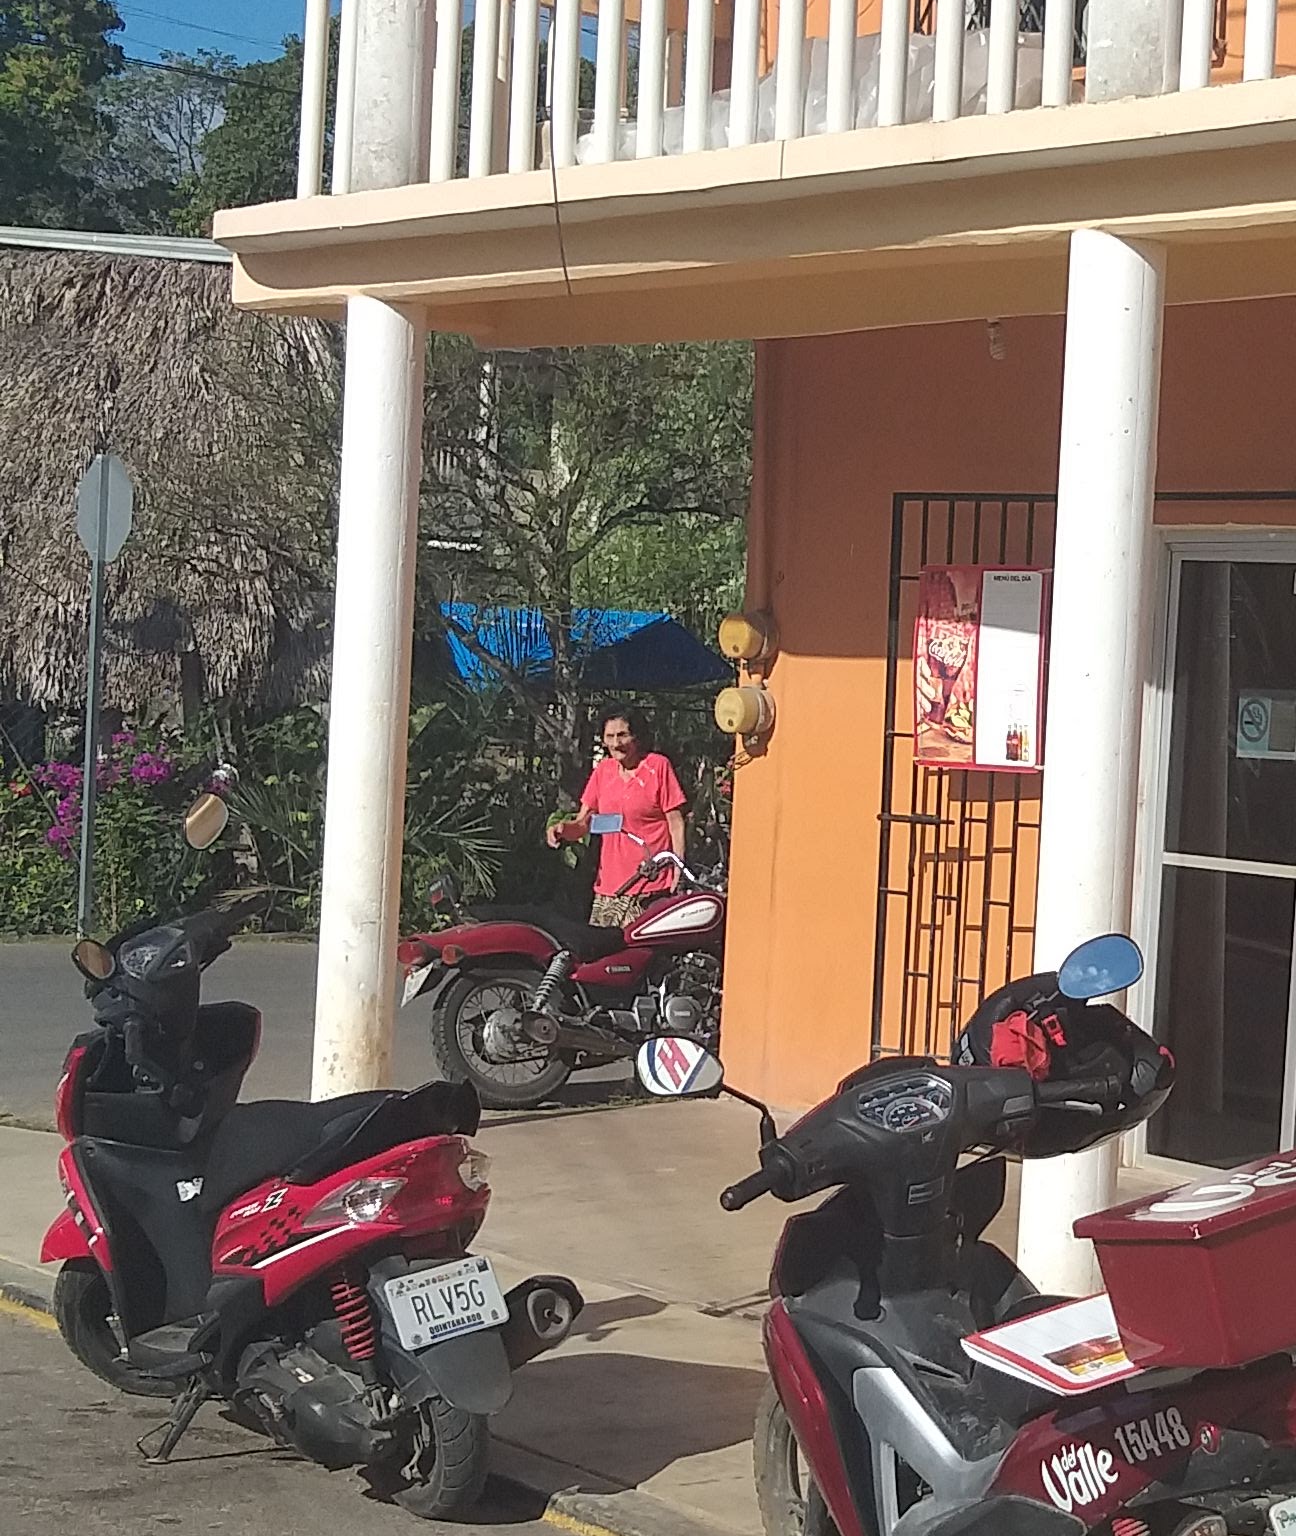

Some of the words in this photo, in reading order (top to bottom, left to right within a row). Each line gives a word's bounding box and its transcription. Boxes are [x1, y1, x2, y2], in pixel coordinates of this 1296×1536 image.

[410, 1279, 486, 1325] RLV5G
[429, 1317, 467, 1334] QUINTANA
[466, 1312, 482, 1323] ROO
[1061, 1443, 1078, 1471] del
[1114, 1407, 1191, 1464] 15448
[1041, 1442, 1119, 1513] Valle
